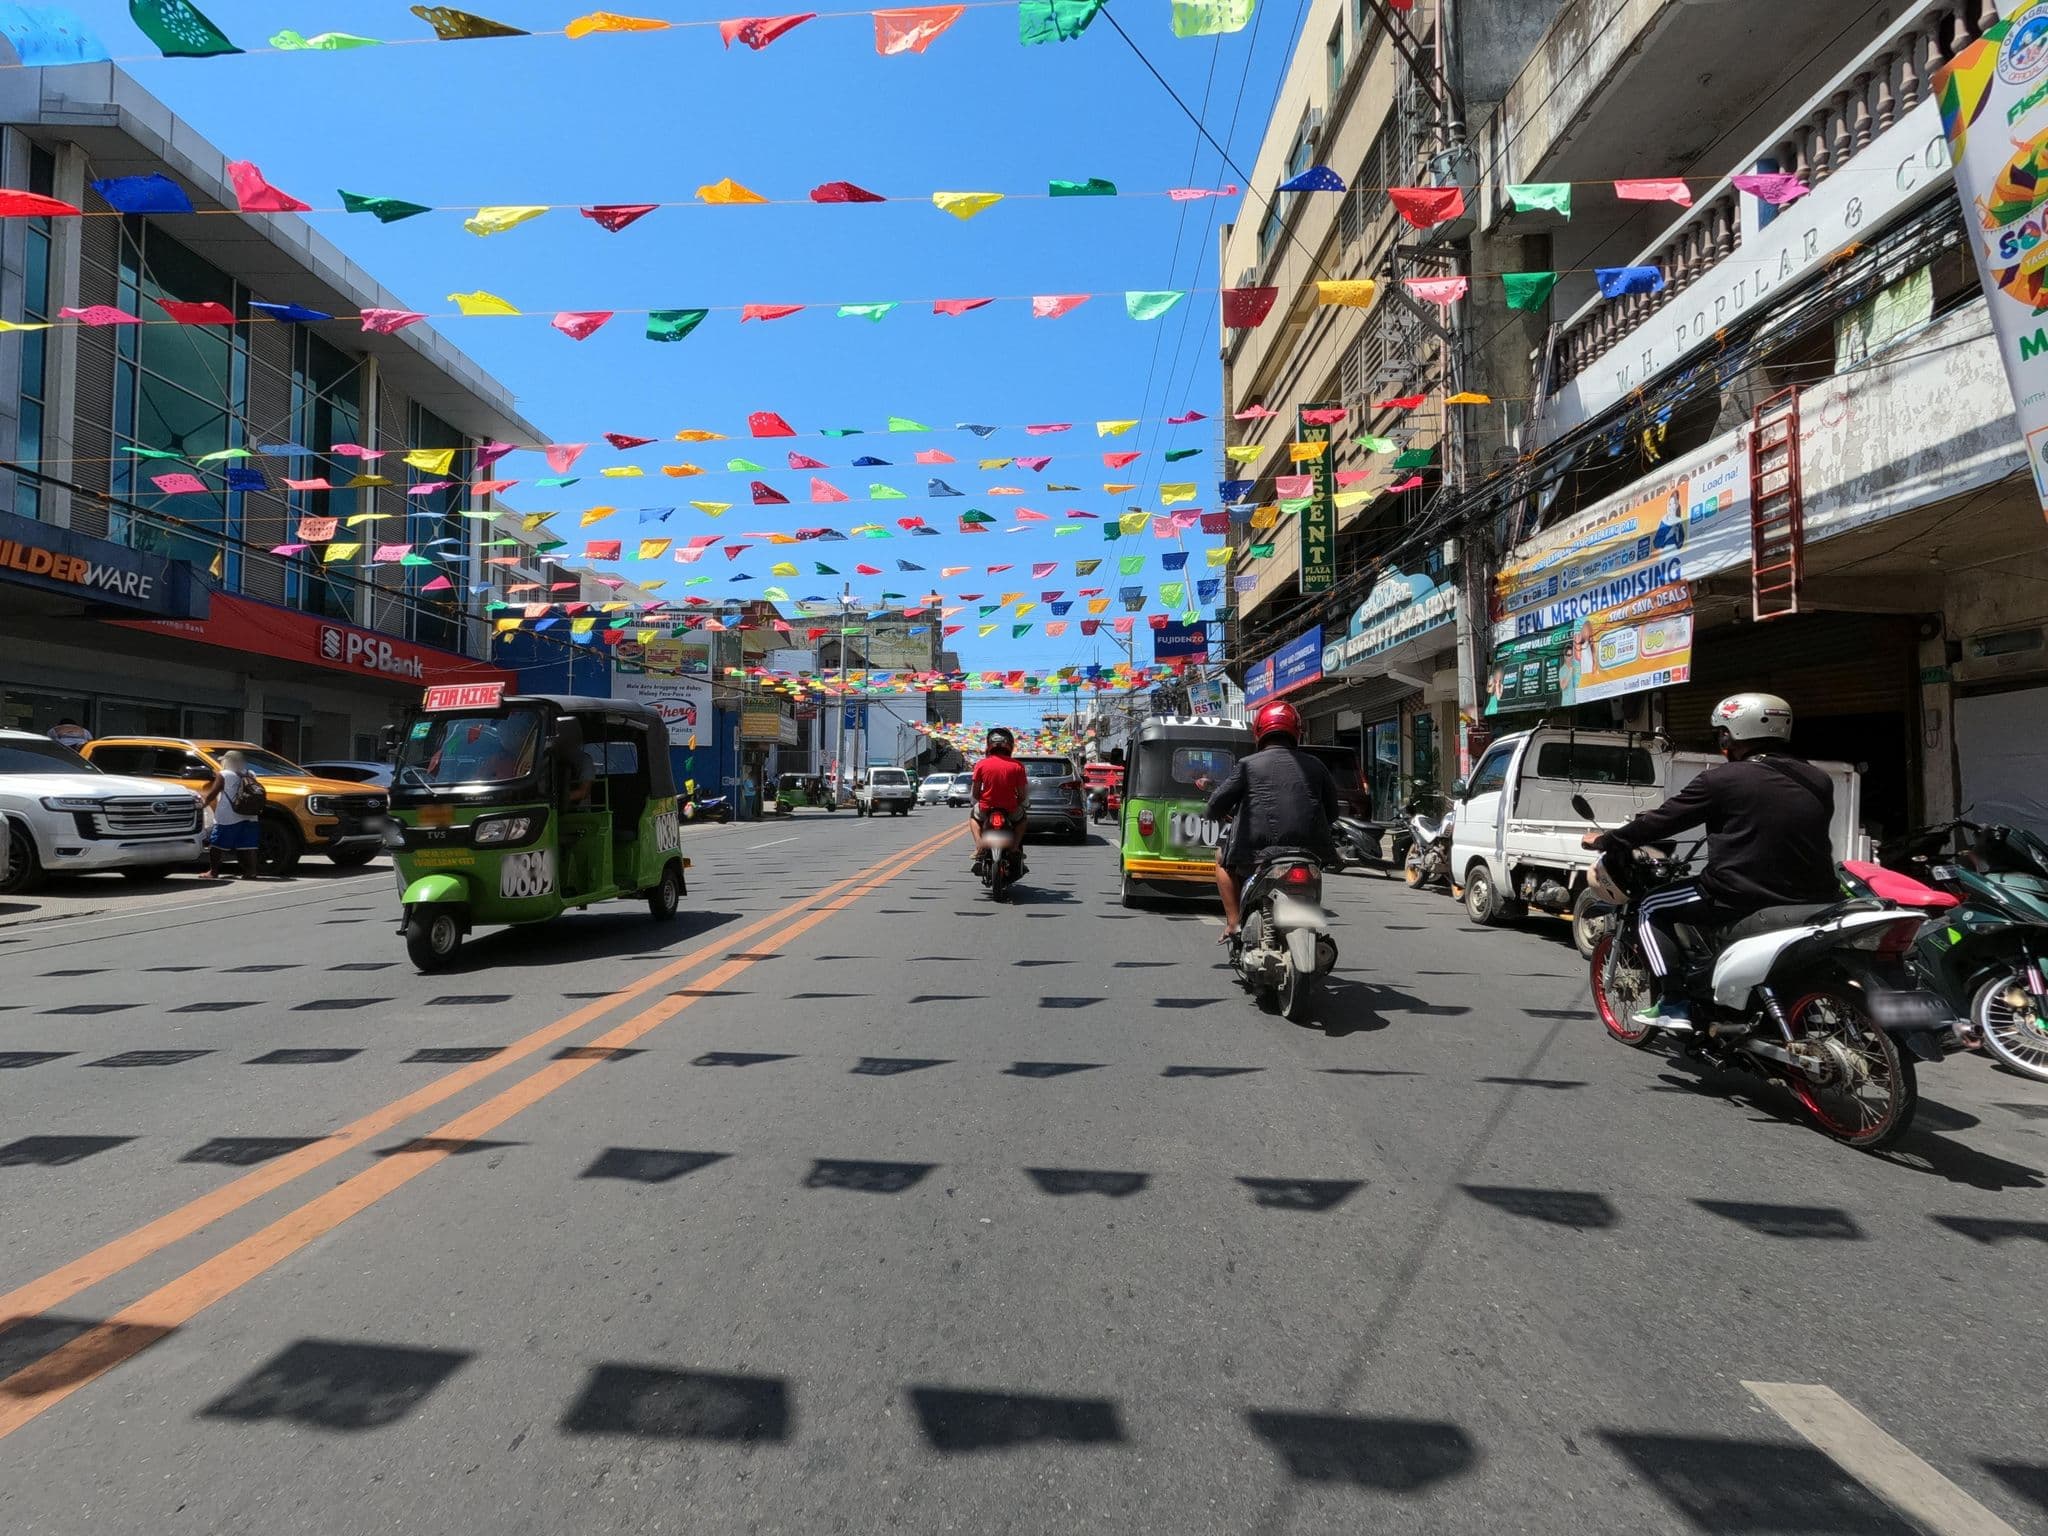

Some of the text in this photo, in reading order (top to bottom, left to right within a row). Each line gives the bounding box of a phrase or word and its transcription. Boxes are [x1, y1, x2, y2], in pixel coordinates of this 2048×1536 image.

[1676, 226, 1820, 353] POPULAR
[1843, 196, 1864, 228] &
[2020, 391, 2047, 408] WITH
[1702, 466, 1739, 493] Load na!
[0, 539, 153, 599] ILDERWARE
[1305, 566, 1331, 574] PLAZA
[1305, 574, 1332, 583] HOTEL
[1551, 557, 1683, 626] MERCHANDISING
[1656, 585, 1689, 607] DEALS
[1157, 635, 1204, 644] FUJIDENZO
[346, 633, 424, 679] PSBank
[428, 685, 500, 708] FOR HIRE
[1194, 700, 1223, 715] RSTW
[671, 726, 692, 734] Paints
[427, 831, 447, 840] TVS
